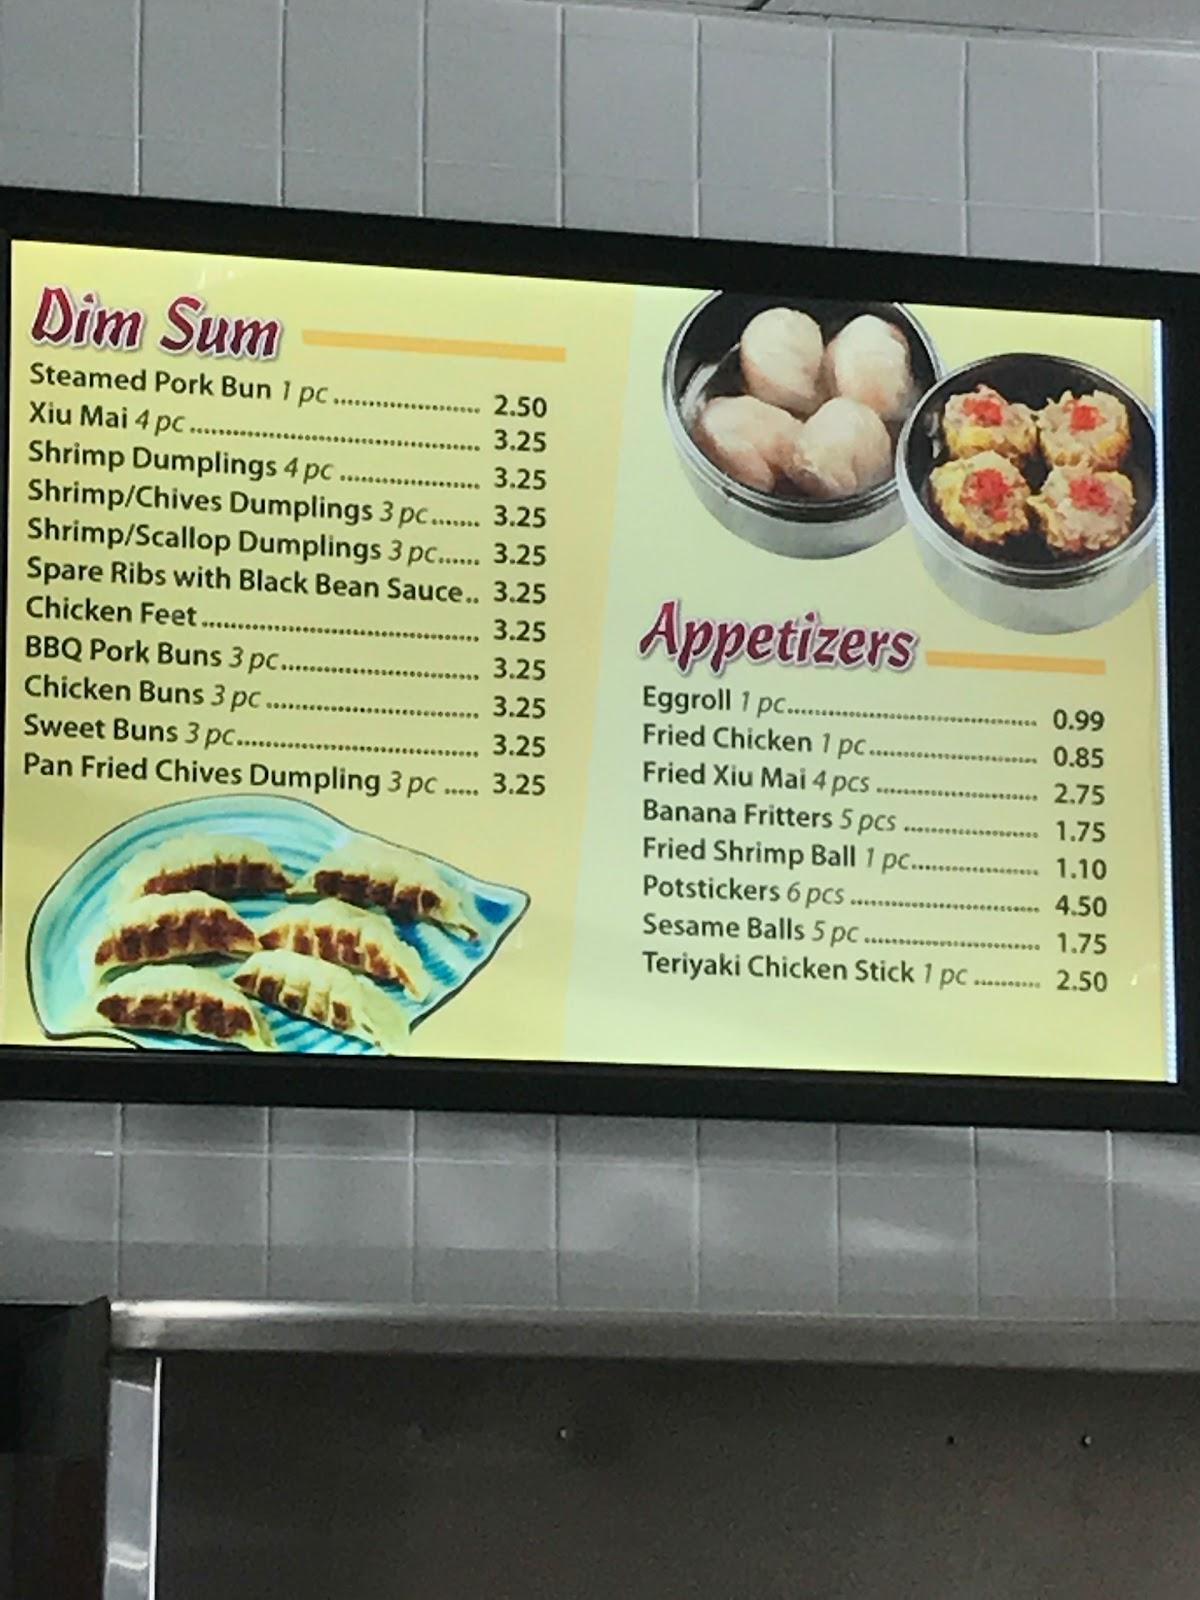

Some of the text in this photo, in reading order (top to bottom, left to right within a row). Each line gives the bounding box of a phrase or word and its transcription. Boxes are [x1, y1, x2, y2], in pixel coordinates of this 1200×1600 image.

[30, 284, 282, 359] Dim Sum
[30, 362, 547, 418] Steamed Pork Bun 1 pc 2.50
[29, 400, 547, 453] Xiu Mai 4 pc 3.25
[28, 440, 547, 490] Shrimp Dumplings 4 pc 3.25
[28, 478, 547, 528] Shrimp/Chives Dumplings 3 pc 3.25
[28, 517, 547, 567] Shrimp/Scallop Dumplings 3 pc 3.25
[27, 556, 546, 605] Spare Ribs with Black Bean Sauce 3.25
[26, 595, 546, 643] Chicken Feet 3.25
[638, 598, 919, 677] Appetizers
[25, 635, 546, 681] BBQ Pork Buns 3 pc 3.25
[25, 674, 546, 719] Chicken Buns 3 pc 3.25
[643, 685, 1105, 732] Eggroll 1 pc 0.99
[24, 713, 545, 758] Sweet Buns 3 pc 3.25
[643, 723, 1104, 768] Fried Chicken 1 pc 0.85
[24, 752, 545, 798] Pan Fried Chives Dumpling 3 pc 3.25
[644, 761, 1105, 806] Fried Xiu Mai 4 pcs 2.75
[643, 799, 1106, 843] Banana Fritters 5 pcs 1.75
[643, 836, 1107, 880] Fried Shrimp Ball 1 pc 1.10
[644, 874, 1107, 917] Potstickers 6 pcs 4.50
[643, 912, 1107, 955] Sesame Balls 5 pc 1.75
[642, 951, 1108, 992] Teriyaki Chicken Stick 1 pc 2.50
